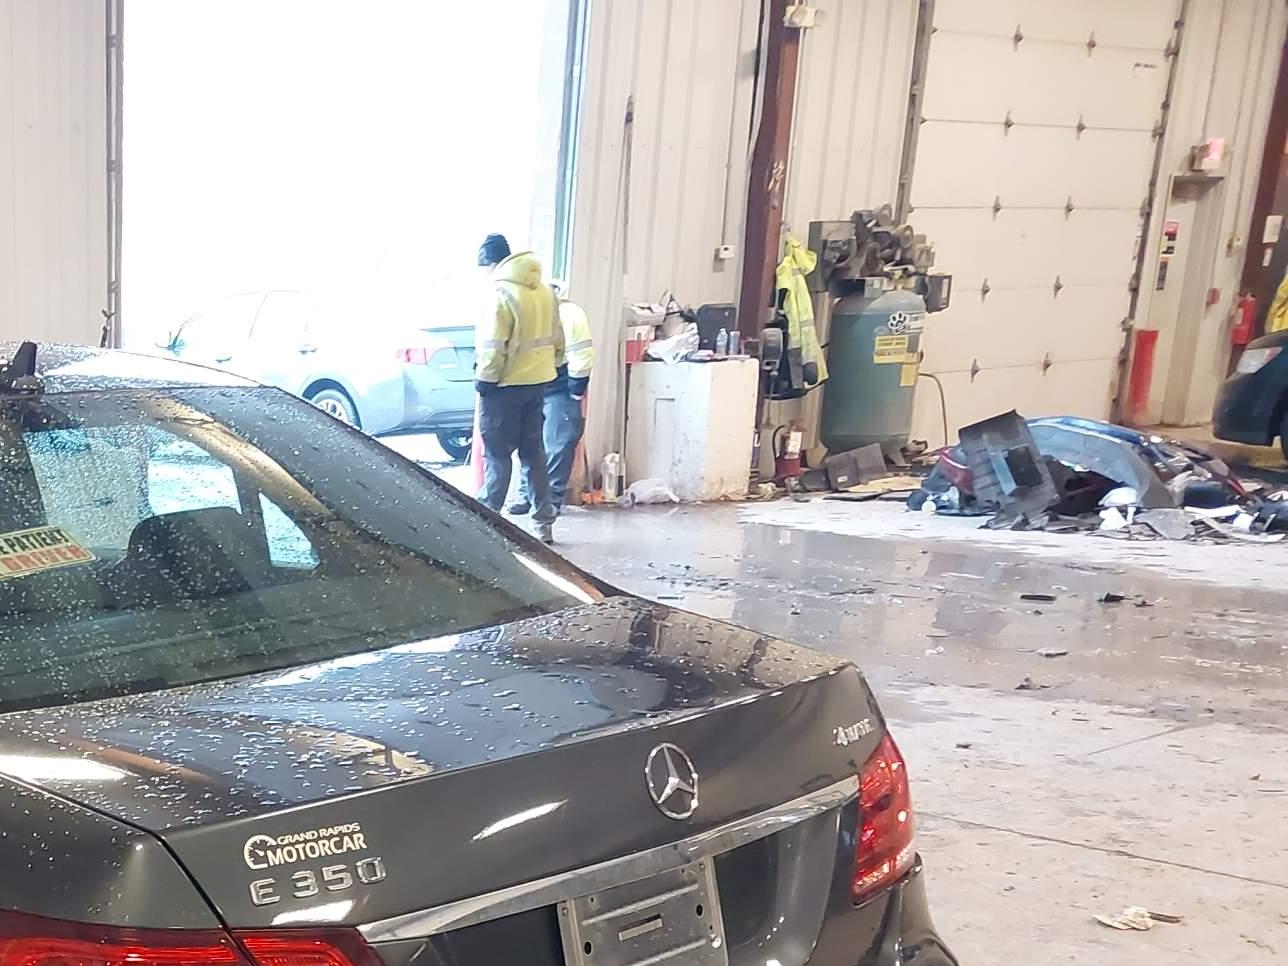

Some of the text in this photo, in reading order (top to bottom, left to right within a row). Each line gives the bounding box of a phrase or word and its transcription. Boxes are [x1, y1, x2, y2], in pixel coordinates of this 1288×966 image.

[3, 528, 69, 553] PATIENT
[276, 822, 361, 846] GRAND RAPIDS
[266, 832, 368, 867] MOTORCAR
[249, 856, 388, 907] E 350
